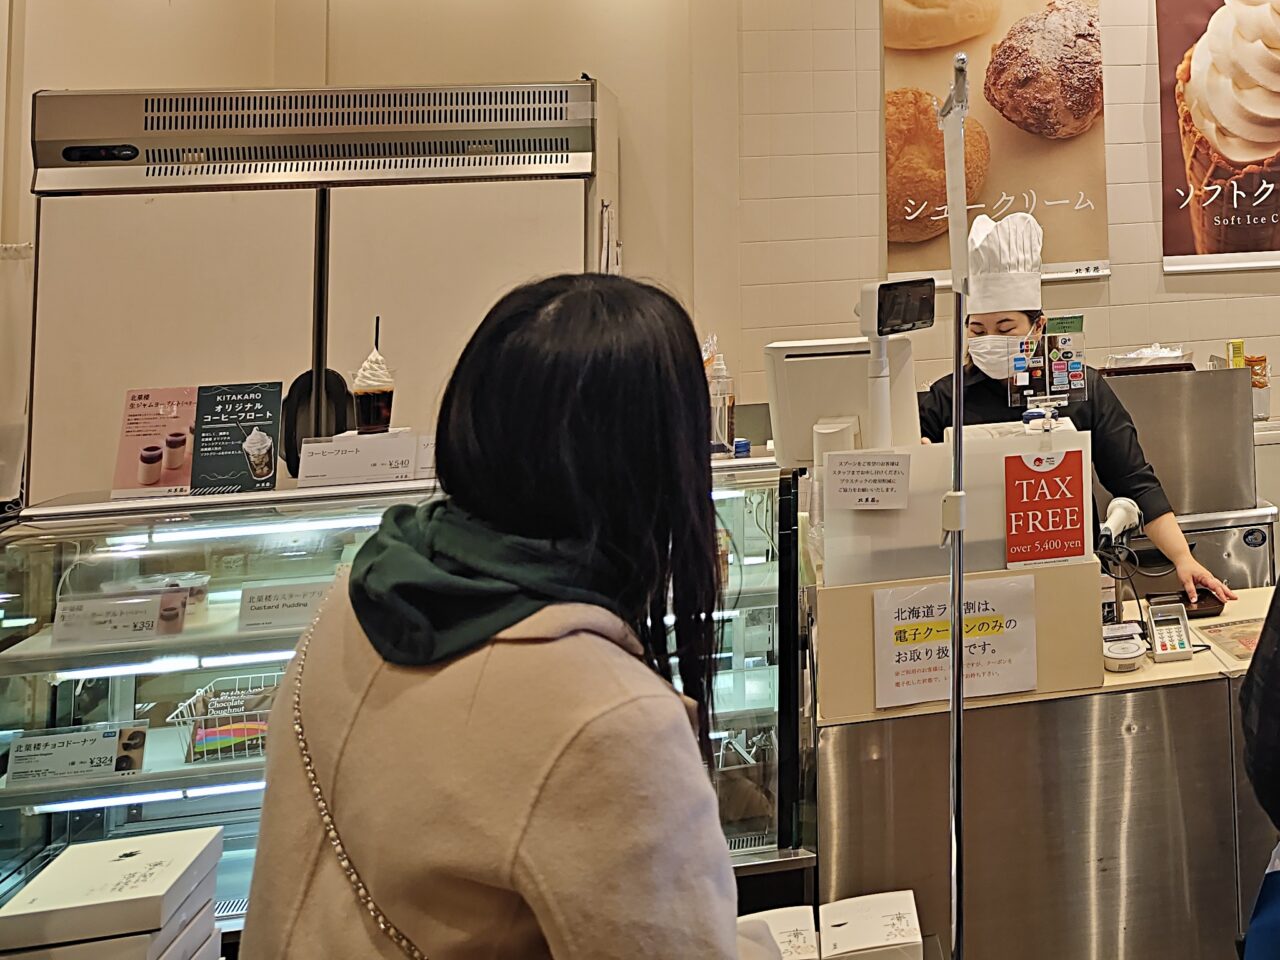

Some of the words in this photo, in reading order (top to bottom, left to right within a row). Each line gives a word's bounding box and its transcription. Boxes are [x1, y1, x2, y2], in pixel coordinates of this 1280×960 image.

[1214, 216, 1242, 226] Soft
[1246, 214, 1267, 224] Ice
[216, 393, 262, 402] KITAKARO
[215, 402, 263, 413] オリジナル
[203, 411, 273, 422] コーヒーフロート
[308, 448, 360, 457] コーヒーフロート
[1015, 476, 1074, 502] TAX
[1009, 507, 1080, 535] FREE
[1010, 543, 1031, 553] over
[1034, 539, 1061, 552] 5,400
[1064, 539, 1081, 551] yen
[894, 600, 996, 621] 北海道ラ割は、
[894, 618, 1017, 642] 電子クーンのみの
[895, 641, 996, 664] お取り扱です。
[208, 699, 245, 709] Chocolate
[208, 706, 245, 715] Doughnut
[15, 738, 97, 753] 北菓楼チョコドーナツ
[89, 756, 113, 765] ¥324
